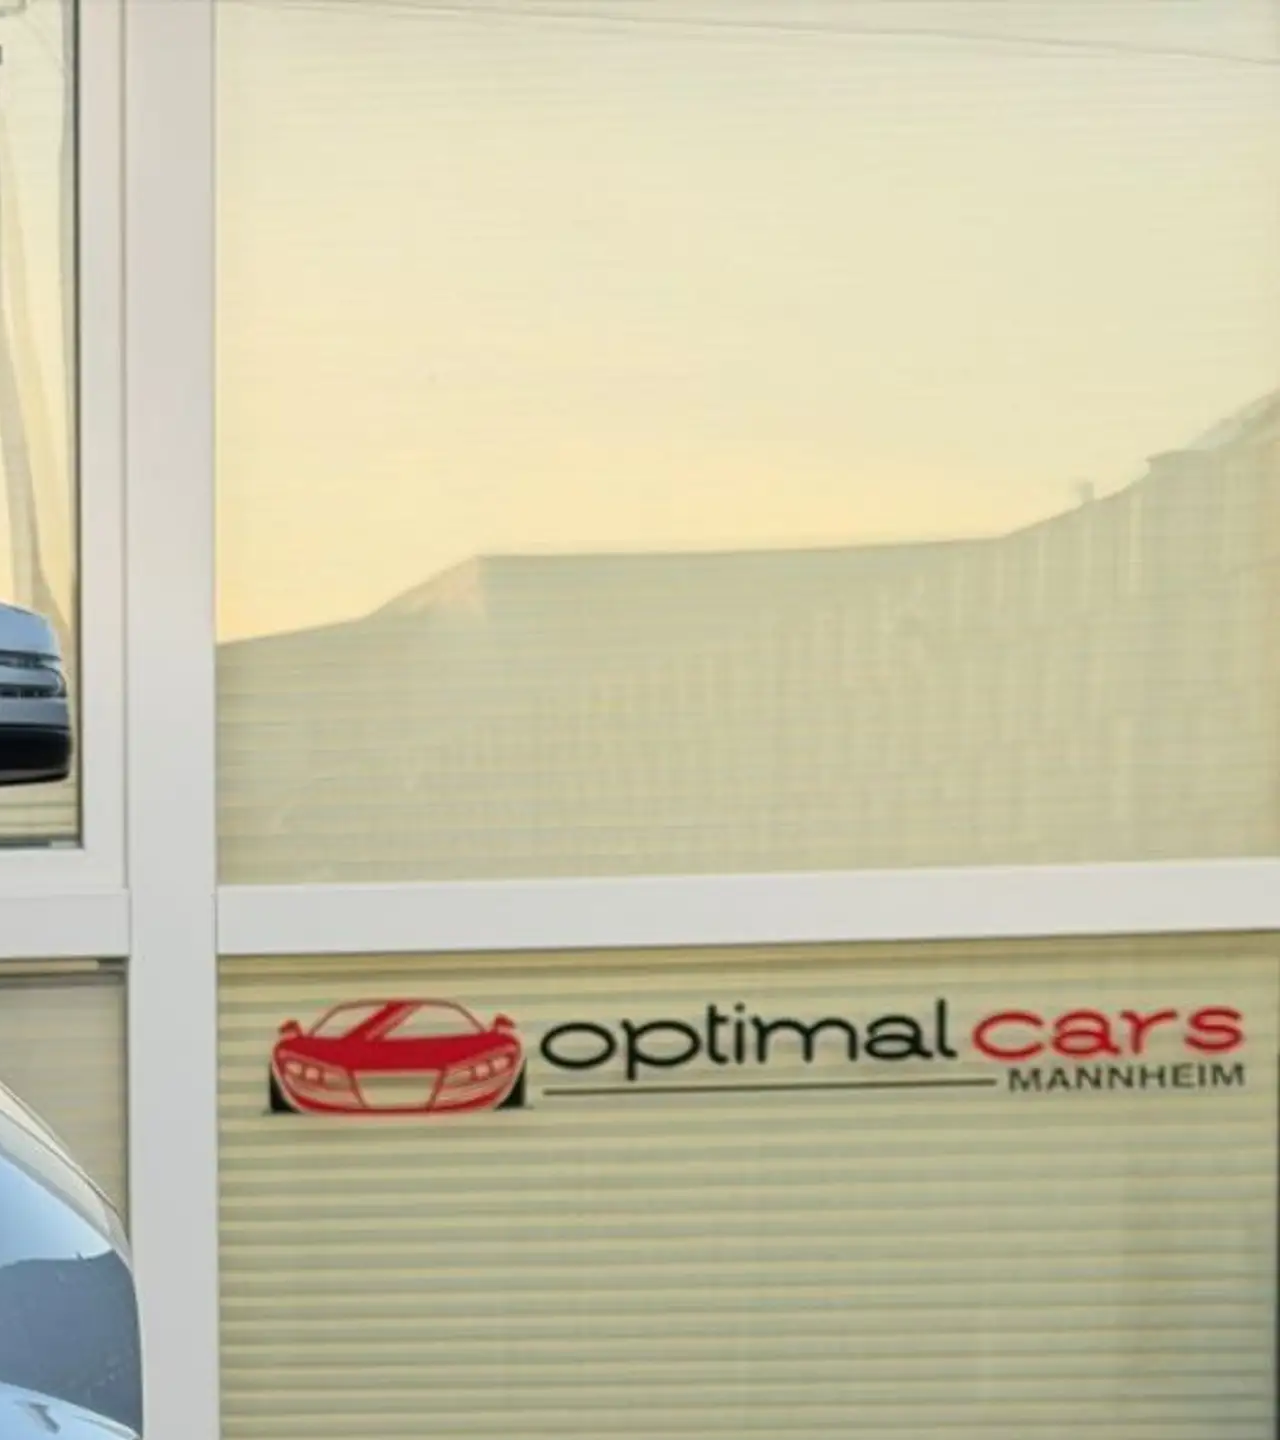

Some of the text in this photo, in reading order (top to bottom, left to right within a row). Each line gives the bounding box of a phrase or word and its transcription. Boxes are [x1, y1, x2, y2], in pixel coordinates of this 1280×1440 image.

[540, 998, 1245, 1080] optimal cars
[1008, 1063, 1245, 1092] MANNHEIM
